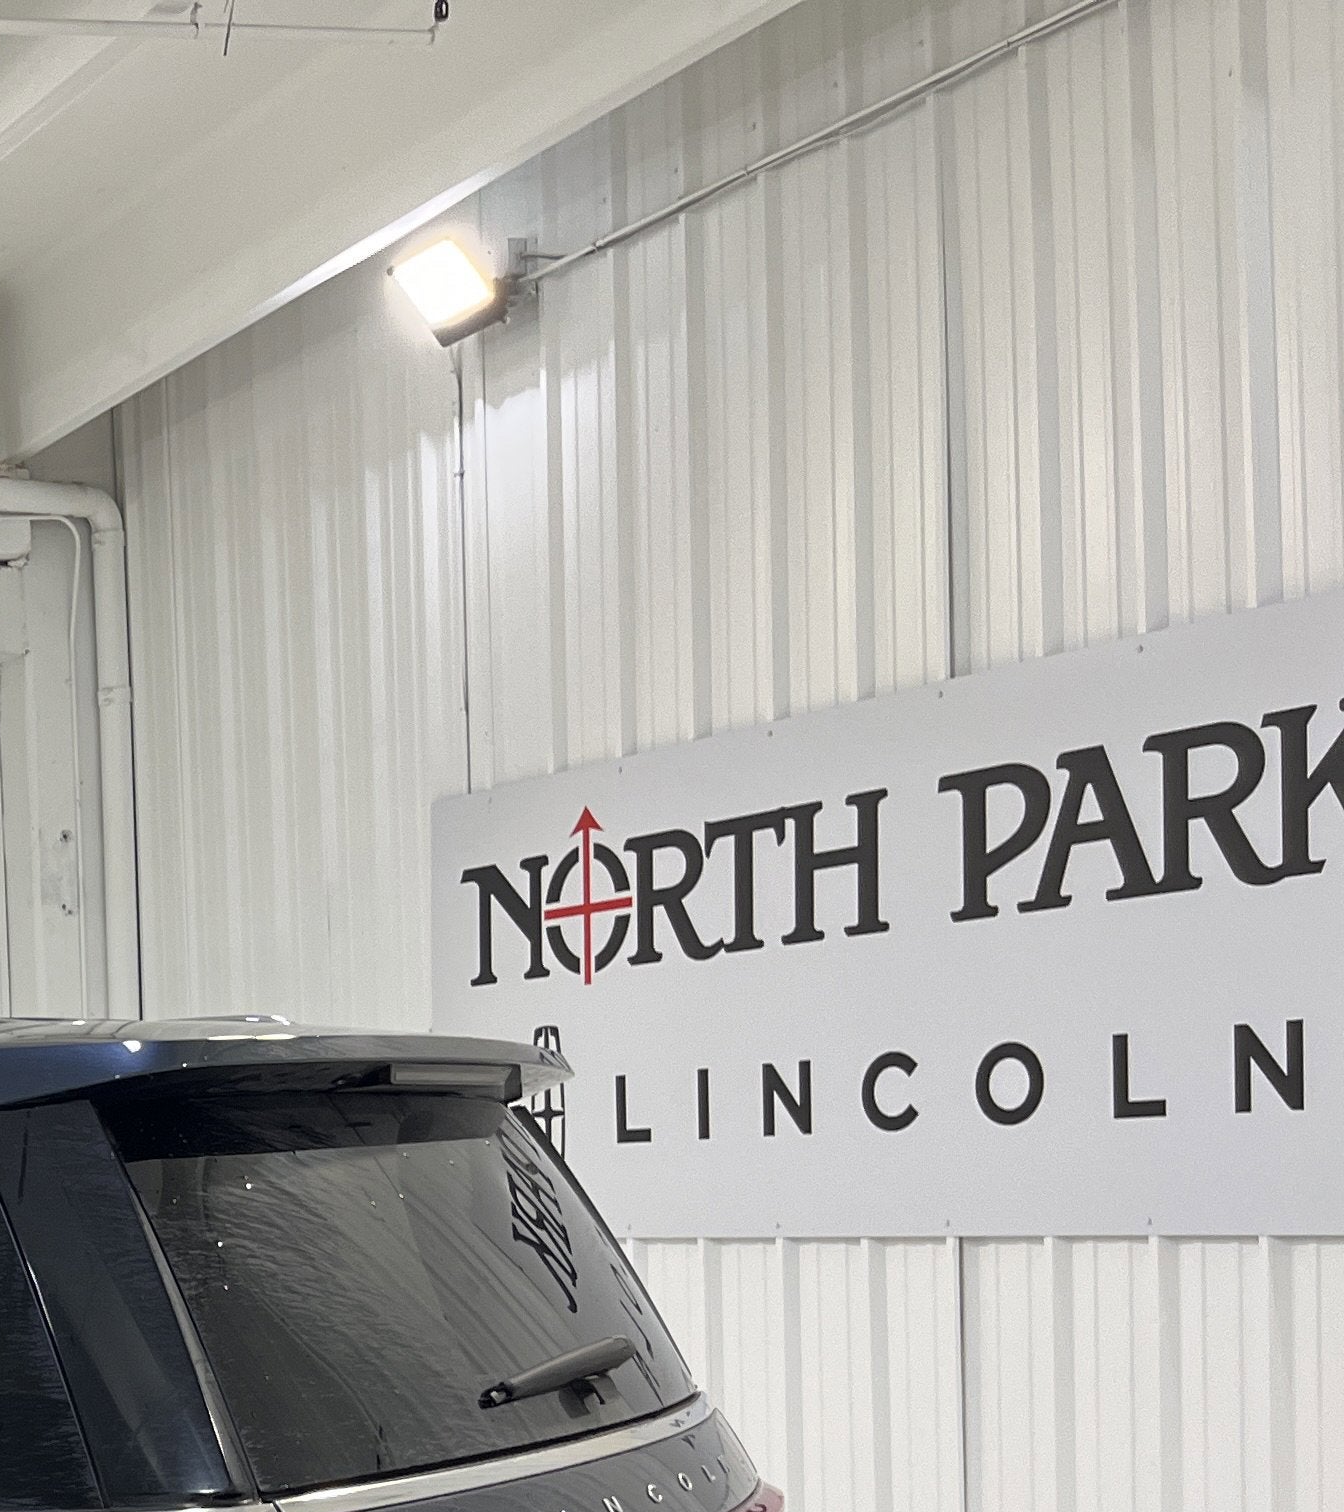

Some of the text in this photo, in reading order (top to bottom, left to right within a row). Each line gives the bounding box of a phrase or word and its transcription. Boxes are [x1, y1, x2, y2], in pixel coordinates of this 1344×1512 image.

[460, 697, 1344, 987] NORTH PARK
[615, 1019, 1305, 1144] LINCOLN
